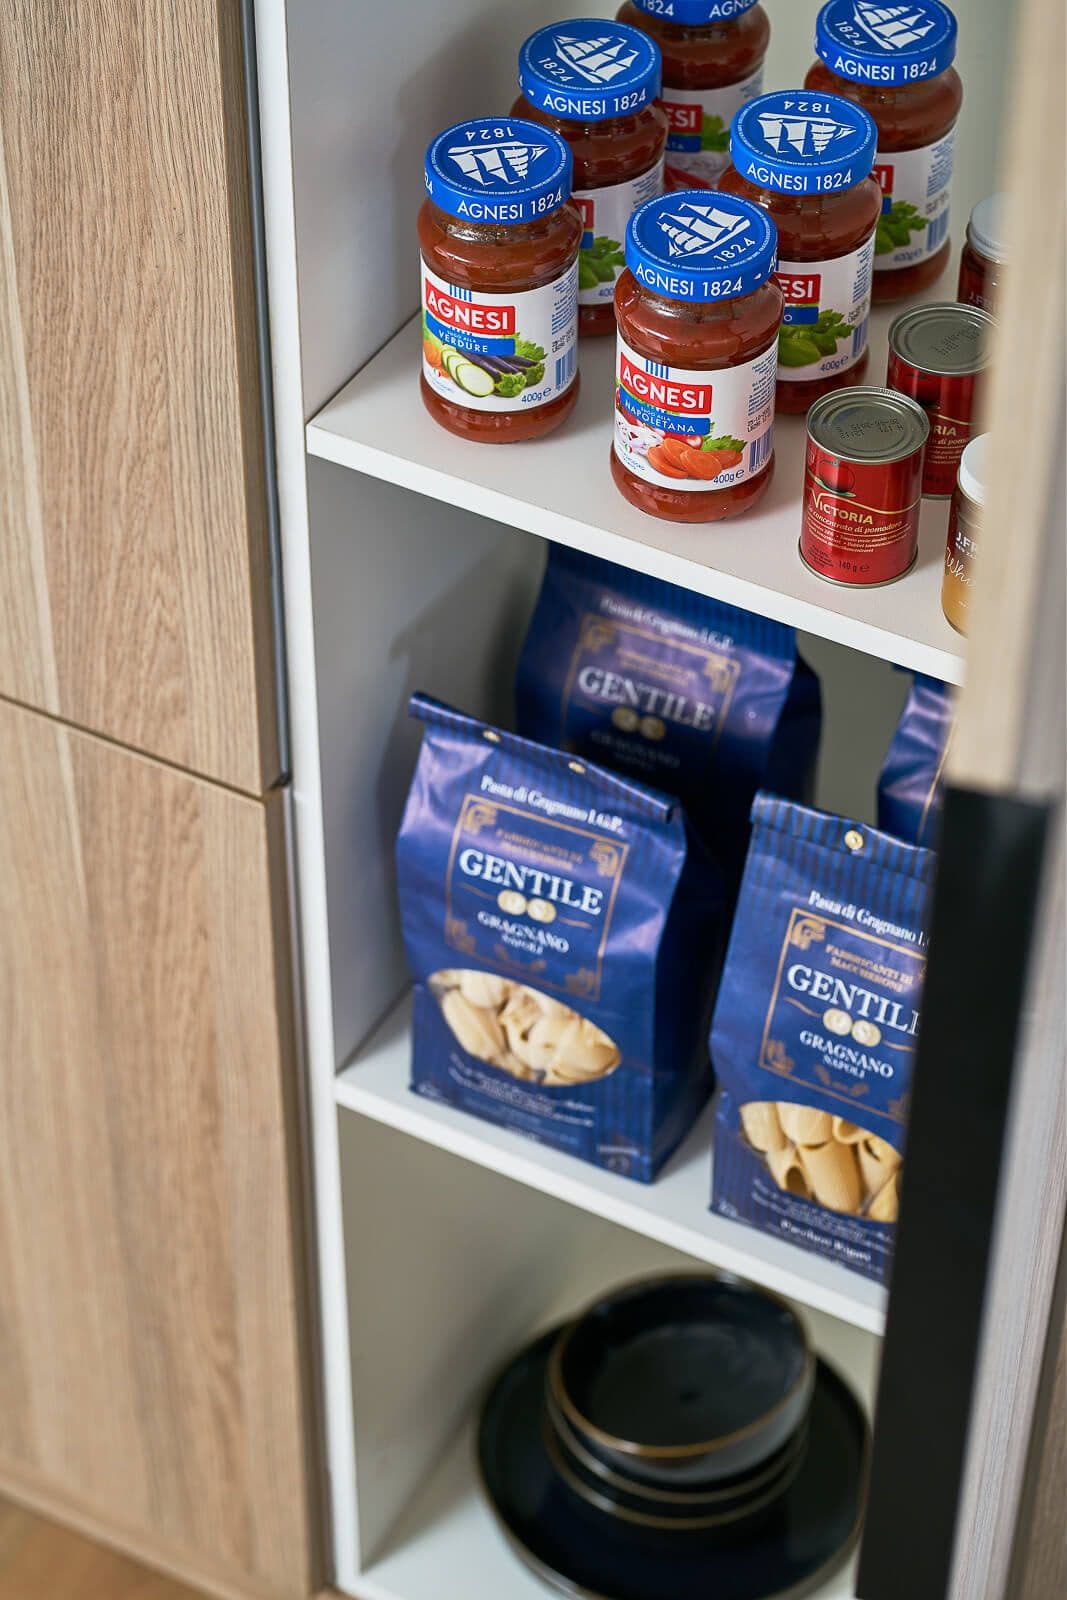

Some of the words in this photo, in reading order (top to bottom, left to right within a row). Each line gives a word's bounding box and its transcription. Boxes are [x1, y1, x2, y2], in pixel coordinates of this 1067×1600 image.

[835, 21, 867, 45] 1824
[538, 57, 575, 81] 1824
[834, 56, 895, 80] AGNESI
[902, 57, 937, 79] 1824
[543, 93, 606, 115] AGNESI
[613, 88, 646, 112] 1824
[784, 100, 831, 114] 1824
[670, 109, 696, 128] ESI
[465, 127, 515, 141] 1824
[747, 162, 808, 191] AGNESI
[816, 168, 852, 191] 1824
[457, 199, 523, 220] AGNESI
[530, 186, 562, 215] 1824
[713, 237, 756, 262] 1824
[635, 262, 694, 296] AGNESI
[702, 276, 743, 297] 1824
[779, 279, 814, 299] ESI
[428, 289, 509, 331] AGNESI
[438, 329, 488, 353] VERDURE
[622, 365, 705, 409] AGNESI
[625, 399, 695, 433] NAPOLETANA
[811, 491, 873, 525] VICTORIA
[578, 665, 715, 732] GENTILE
[459, 848, 604, 916] GENTILE
[477, 911, 569, 953] GRAGNANO
[799, 1030, 894, 1078] GRAGNANO
